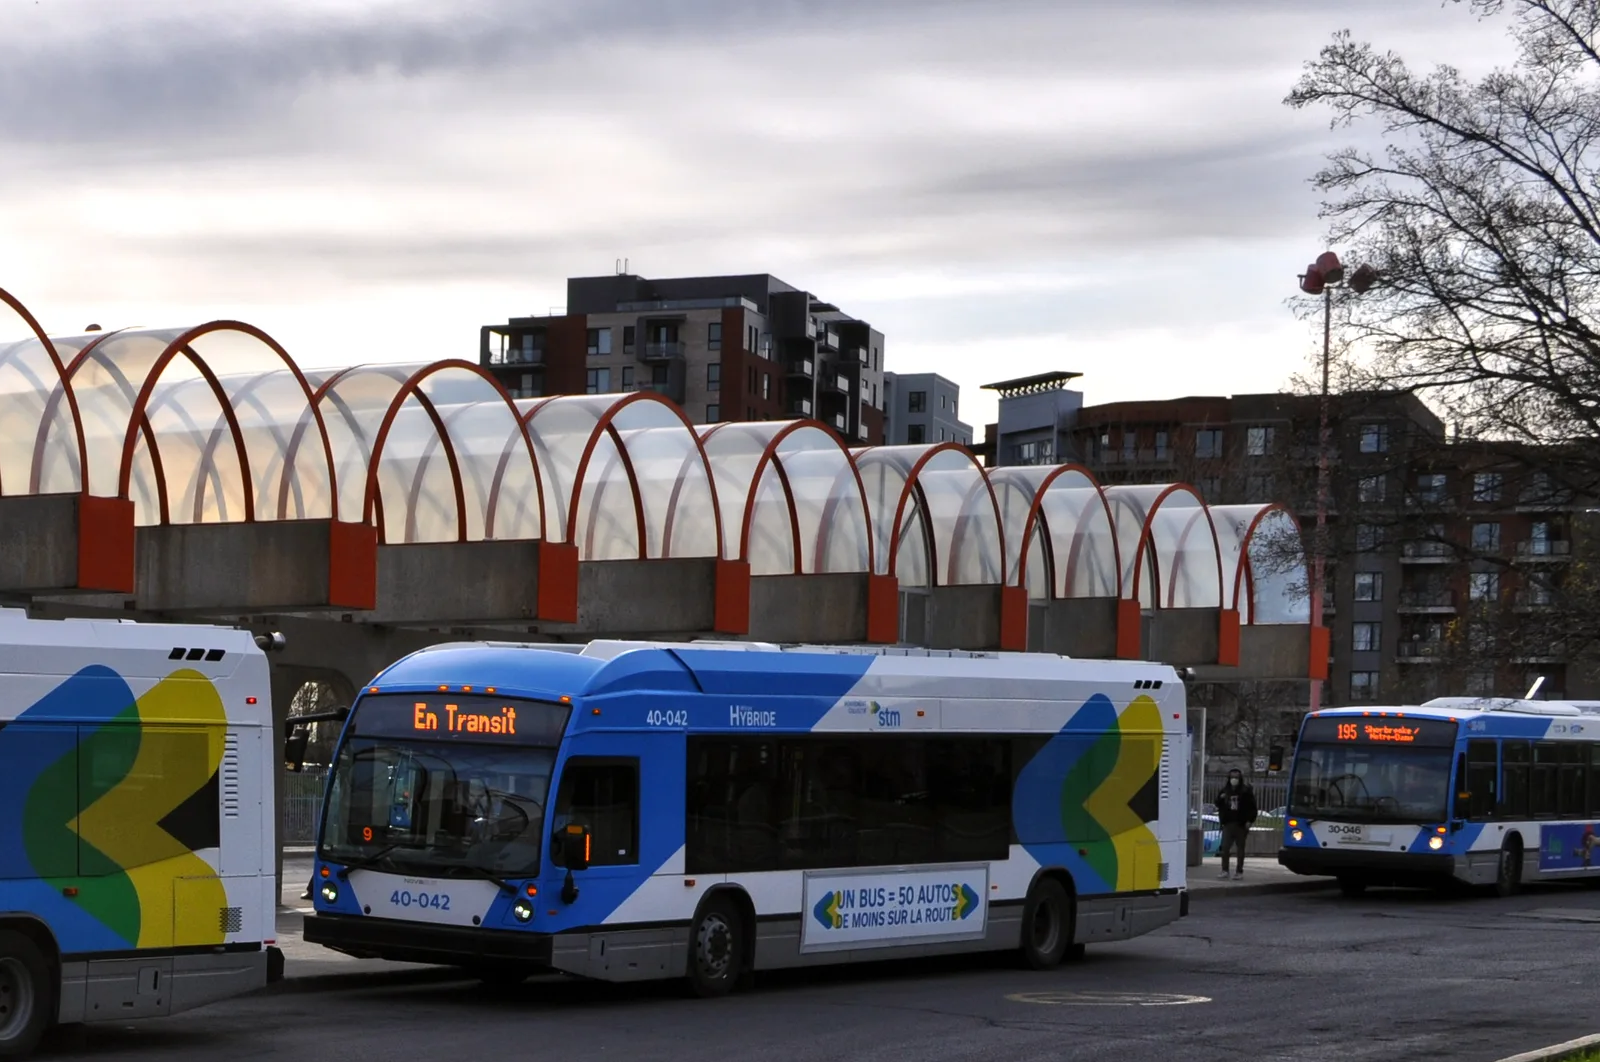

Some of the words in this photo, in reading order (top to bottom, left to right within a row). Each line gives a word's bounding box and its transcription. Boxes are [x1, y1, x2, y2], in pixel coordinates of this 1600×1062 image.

[414, 702, 438, 730] En
[445, 704, 516, 734] Transit
[646, 710, 688, 726] 40-042
[730, 705, 776, 726] HYBRIDE
[878, 708, 900, 727] stm
[1337, 723, 1357, 740] 195
[363, 826, 373, 841] 9
[1328, 825, 1361, 834] 30-046
[390, 890, 450, 911] 40-042
[837, 890, 855, 909] UN
[860, 888, 885, 908] BUS
[888, 892, 895, 901] =
[899, 886, 914, 905] 50
[918, 883, 958, 904] AUTOS
[837, 913, 848, 929] DE
[852, 911, 885, 928] MOINS
[888, 910, 907, 925] SUR
[911, 908, 922, 923] LA
[925, 906, 957, 923] ROUTE
